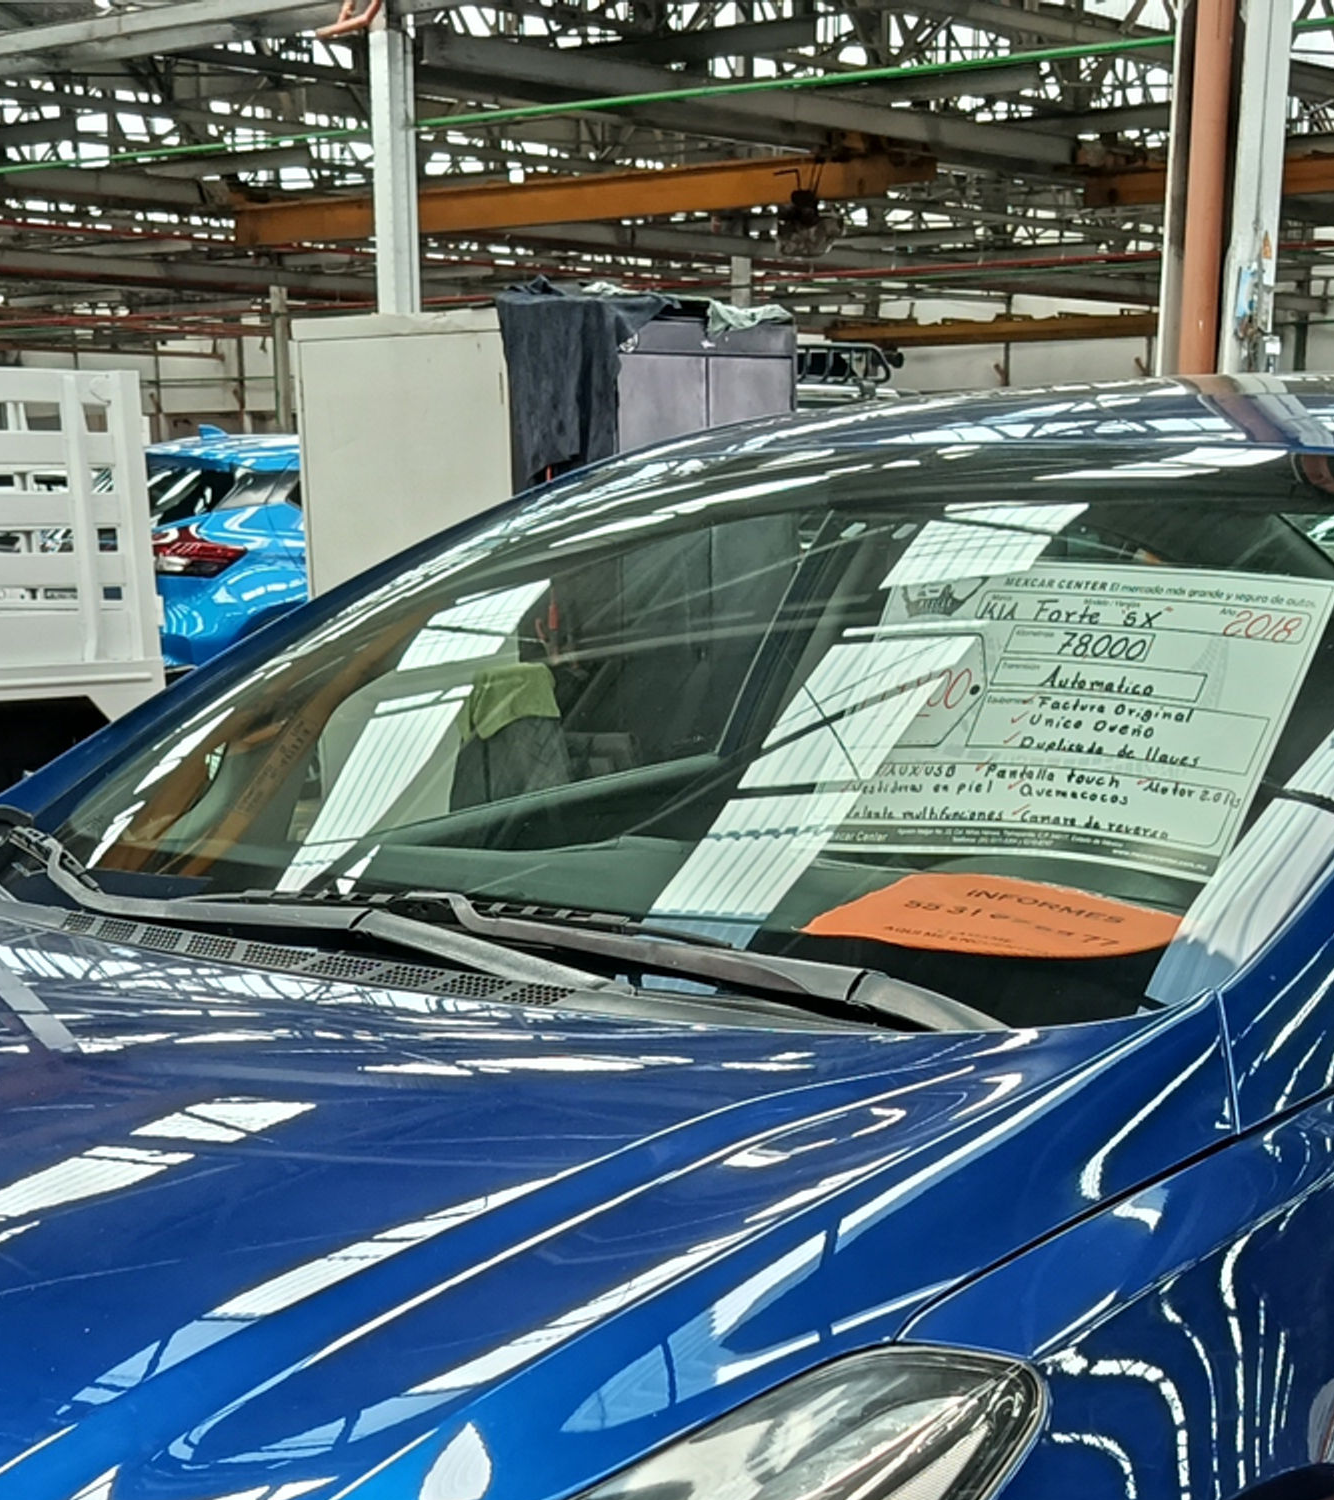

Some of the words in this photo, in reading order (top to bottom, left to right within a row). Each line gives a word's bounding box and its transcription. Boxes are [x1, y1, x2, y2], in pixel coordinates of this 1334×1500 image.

[1004, 577, 1055, 589] MEXCAR
[1057, 578, 1108, 591] CENTER
[1121, 584, 1164, 595] mercado
[977, 601, 1019, 621] KIA
[1033, 599, 1101, 624] Forte
[1223, 610, 1303, 643] 2018
[1039, 665, 1154, 696] Automatico
[1037, 696, 1106, 714] Factura
[1114, 704, 1194, 723] Original
[1029, 714, 1083, 730] Unico
[1117, 744, 1135, 759] de
[1146, 747, 1200, 768] llaves
[933, 782, 950, 793] en
[957, 780, 993, 795] piel
[984, 764, 1055, 781] Pantalla
[1067, 769, 1120, 788] touch
[966, 889, 1125, 924] INFORMES
